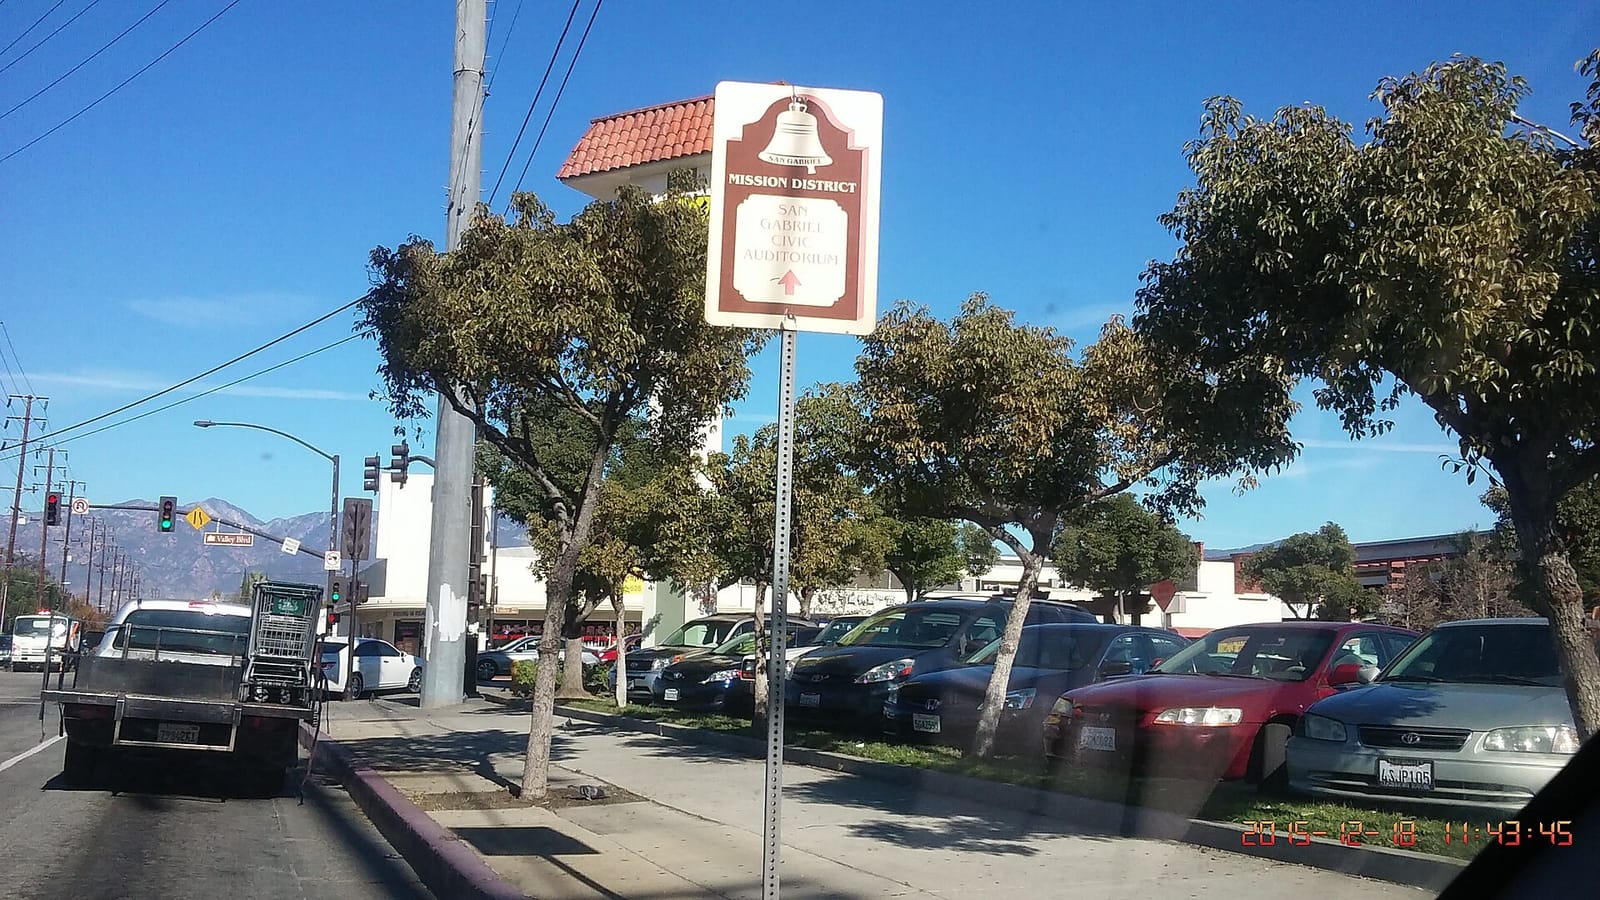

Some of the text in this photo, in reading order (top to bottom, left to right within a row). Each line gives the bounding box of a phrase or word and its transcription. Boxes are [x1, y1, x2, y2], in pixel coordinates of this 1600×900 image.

[728, 173, 857, 193] MISSION DISTRICT
[778, 203, 808, 216] SAN
[760, 218, 825, 233] GABRIEL
[771, 234, 811, 248] CIVIC
[743, 248, 838, 265] AUDITORIUM
[215, 535, 251, 545] Valley Blvd
[1381, 768, 1431, 785] 4SJP105
